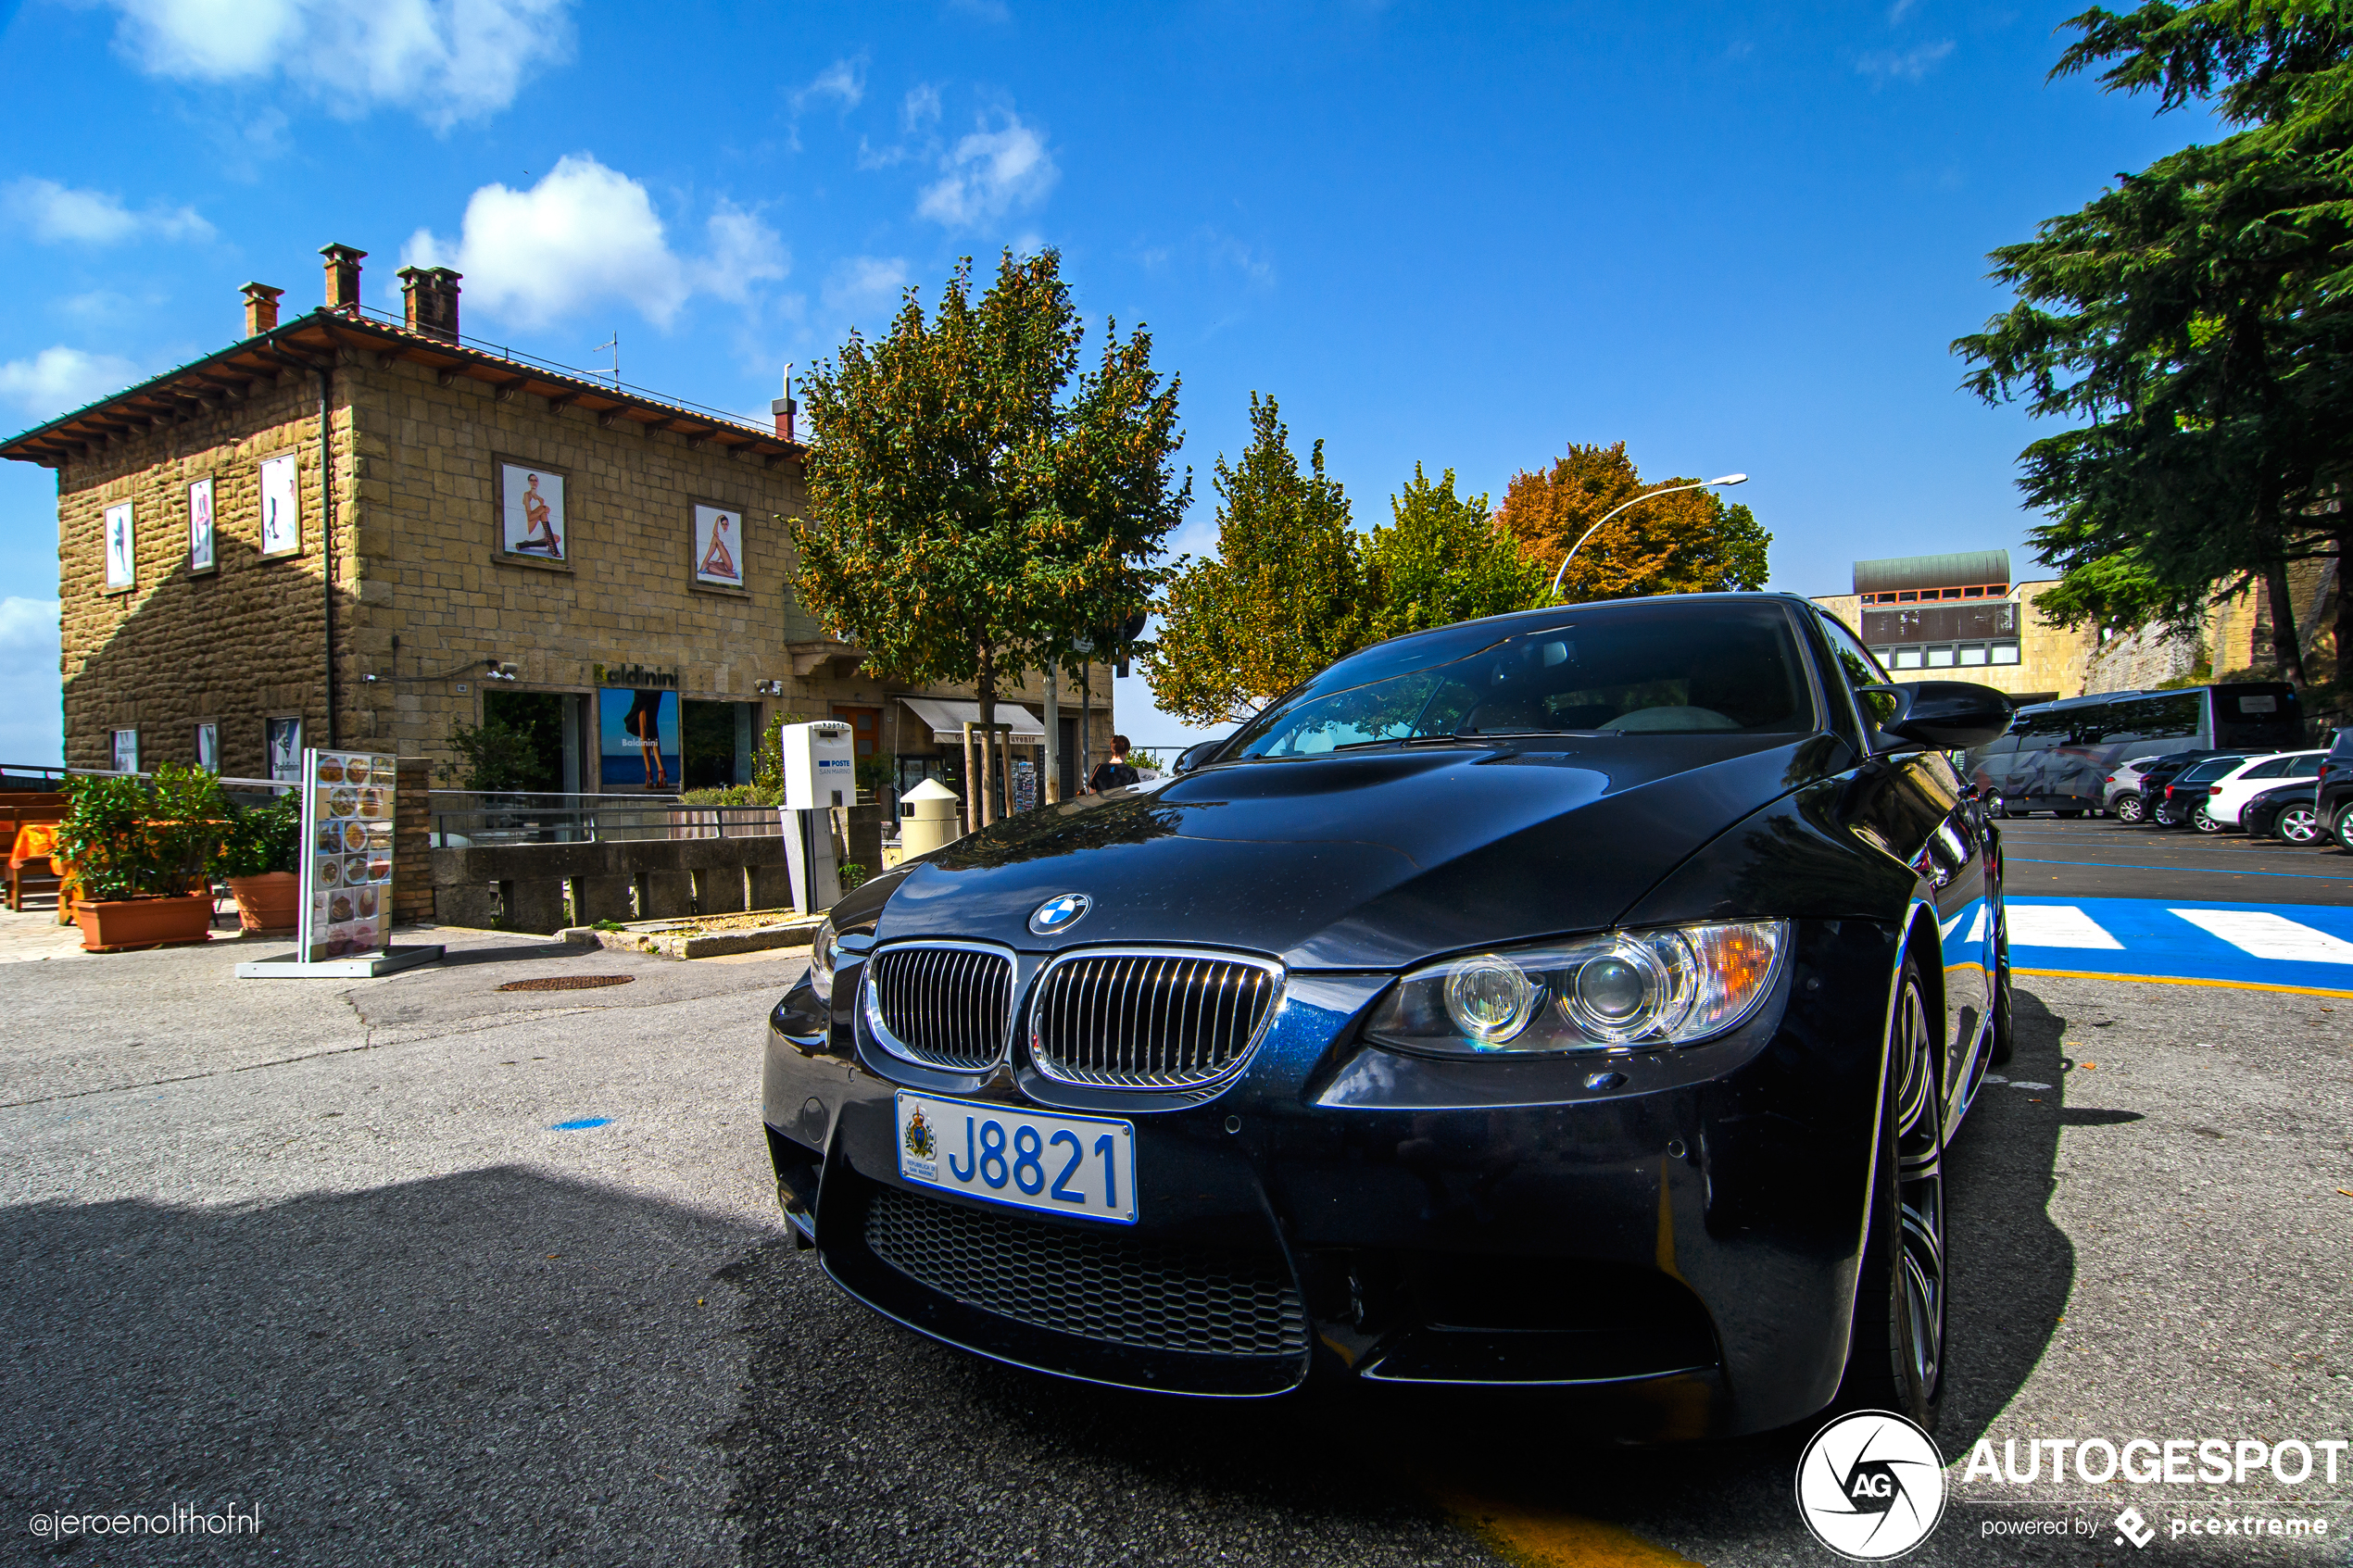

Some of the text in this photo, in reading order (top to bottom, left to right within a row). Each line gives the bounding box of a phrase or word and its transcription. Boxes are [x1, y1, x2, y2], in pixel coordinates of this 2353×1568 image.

[594, 663, 679, 685] Baldinini
[622, 738, 659, 747] Baldinini
[907, 1160, 929, 1170] REPUBBLICA
[949, 1115, 1116, 1208] J8821
[918, 1168, 935, 1177] MARINO
